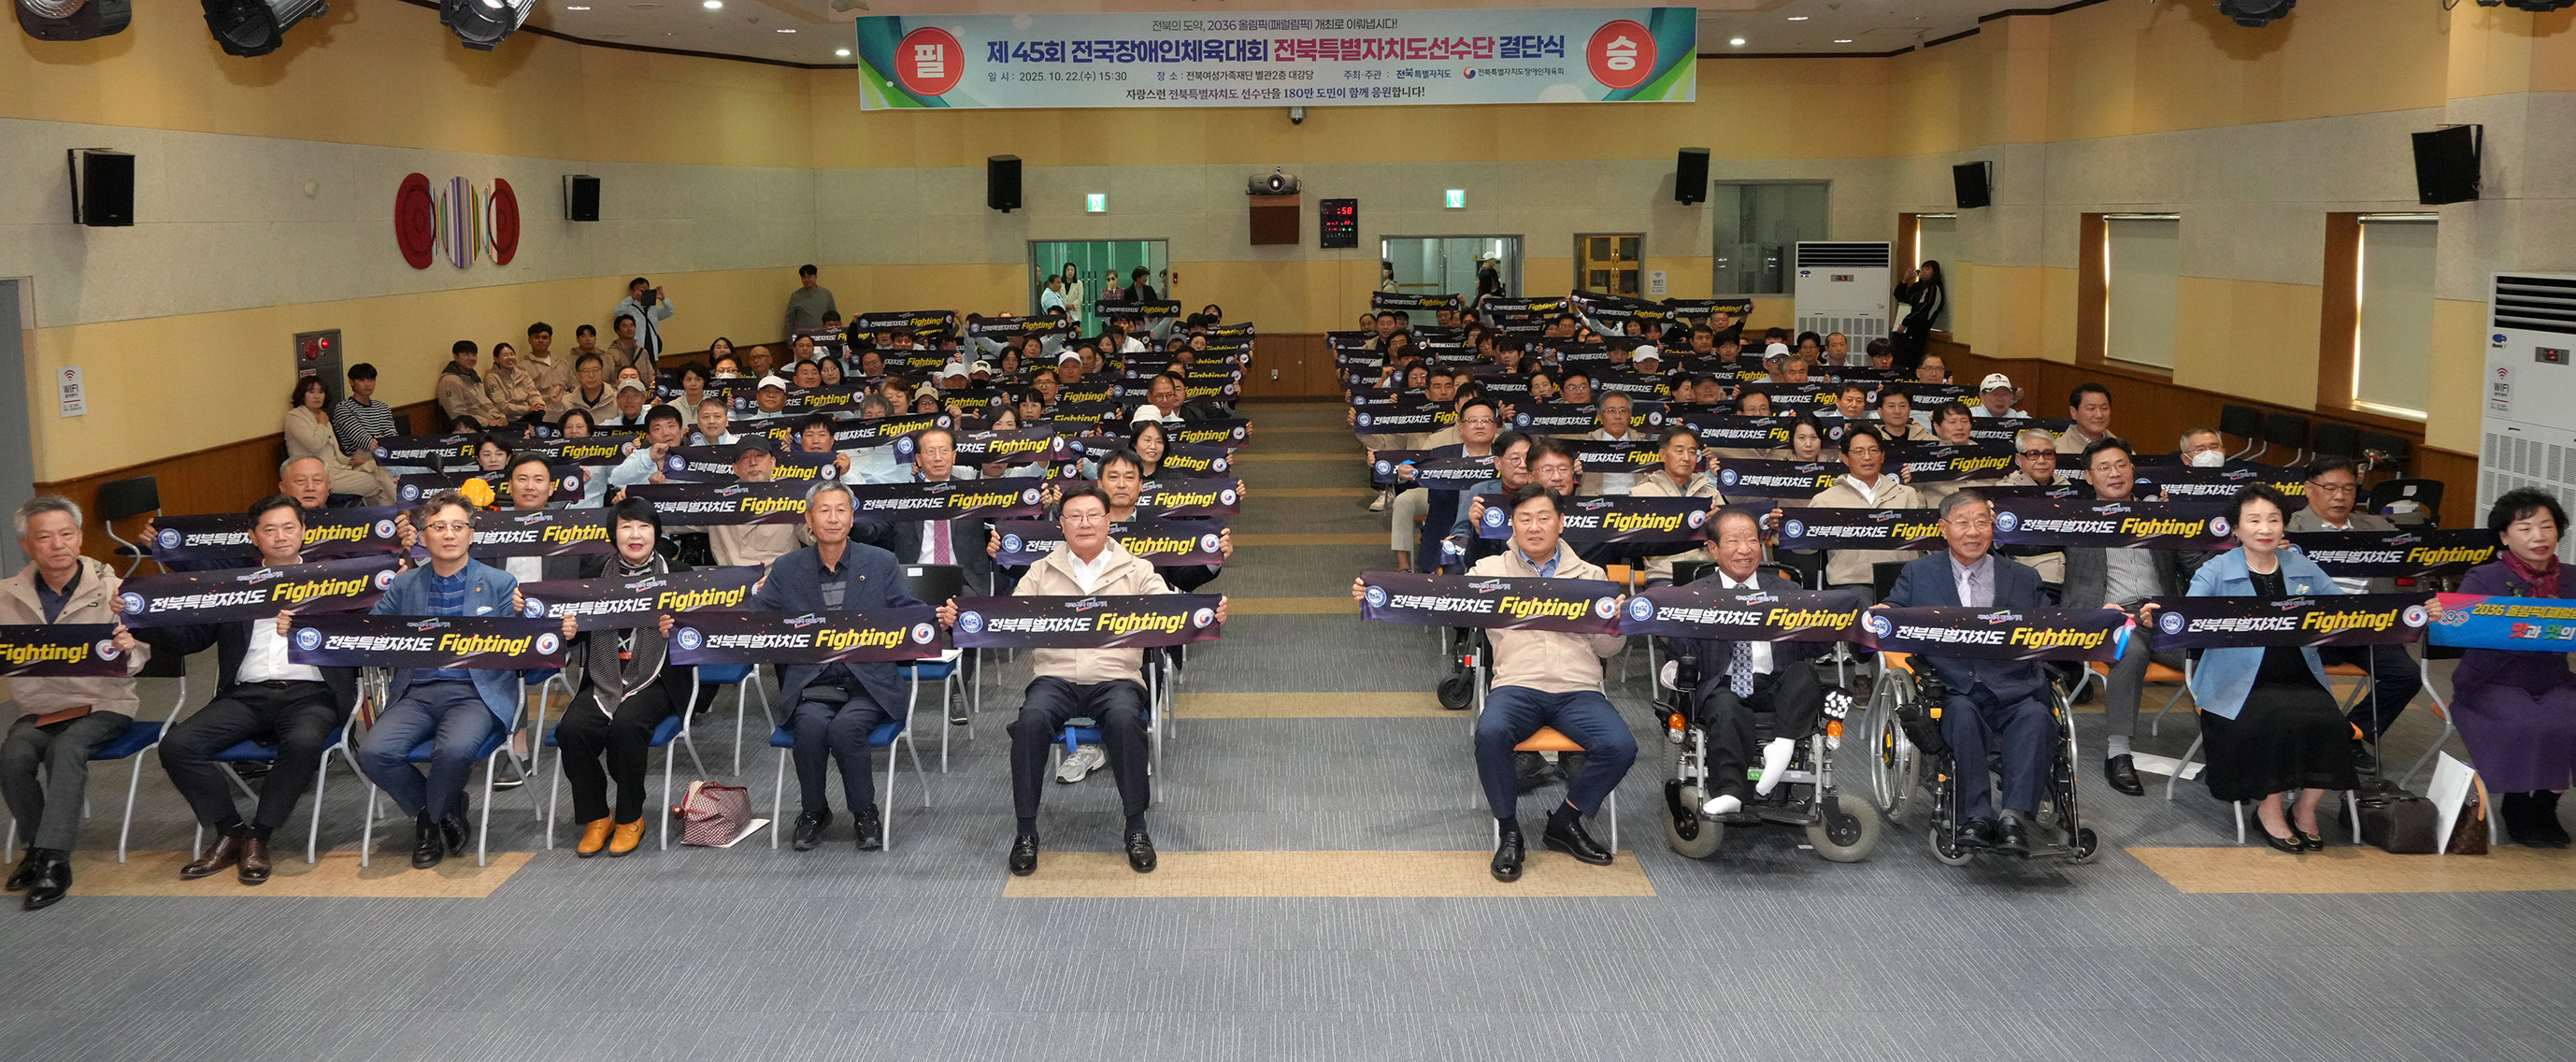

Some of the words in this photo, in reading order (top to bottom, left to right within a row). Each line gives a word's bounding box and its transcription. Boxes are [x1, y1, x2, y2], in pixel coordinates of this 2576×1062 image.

[1152, 20, 1181, 32] 전북의
[1183, 20, 1206, 33] 도약,
[1208, 20, 1237, 31] 2036
[1238, 19, 1312, 31] 올림픽(패럴림픽)
[1315, 19, 1344, 30] 개최로
[1346, 18, 1398, 30] 이뤄냅시다!
[987, 40, 1009, 63] 제
[1011, 40, 1066, 63] 45회
[1071, 39, 1268, 64] 전국장애인체육대회
[1274, 36, 1495, 62] 전북특별자치도선수단
[1499, 35, 1565, 59] 결단식
[1606, 35, 1638, 71] 승
[913, 43, 945, 79] 필
[1019, 71, 1046, 81] 2025.
[1049, 71, 1064, 81] 10.
[1066, 71, 1096, 82] 22.(수)
[1099, 71, 1127, 81] 15:30
[1186, 70, 1253, 81] 전북여성가족재단
[1255, 70, 1287, 80] 별관2층
[1288, 69, 1314, 80] 대강당
[1343, 69, 1381, 80] 주최·주관
[1477, 65, 1565, 77] 전북특별자치도장애인체육회
[1125, 88, 1166, 100] 자랑스런
[1168, 88, 1238, 100] 전북특별자치도
[1241, 87, 1281, 100] 선수단을
[1283, 87, 1314, 99] 180만
[1316, 86, 1346, 99] 도민이
[1349, 86, 1369, 98] 함께
[1371, 85, 1425, 98] 응원합니다!
[1418, 298, 1449, 307] Fighting!
[909, 317, 944, 326] Fighting!
[1634, 309, 1666, 320] Fighting!
[1021, 321, 1056, 330] Fighting!
[907, 357, 945, 367] Fighting!
[63, 383, 79, 393] WIFI
[1601, 382, 1653, 393] 전북특별자치도
[2494, 381, 2510, 393] WIFI
[804, 393, 851, 407] Fighting!
[1063, 391, 1108, 403] Fighting!
[1373, 413, 1432, 425] 전북특별자치도
[1532, 416, 1592, 426] 전북특별자치도
[879, 419, 934, 437] Fighting!
[1180, 429, 1230, 442] Fighting!
[1701, 428, 1767, 439] 전북특별자치도
[561, 444, 619, 459] Fighting!
[988, 438, 1051, 453] Fighting!
[1164, 456, 1210, 470] ghting!
[1949, 454, 2012, 471] Fighting!
[770, 465, 818, 481] ghting!
[1420, 468, 1494, 480] 전북특별자치도
[1739, 475, 1813, 488] 전북특별자치도
[653, 500, 737, 513] 전북특별자치도
[739, 497, 806, 514] Fighting
[863, 498, 944, 510] 전북특별자치도
[948, 491, 1019, 509] Fighting!
[1154, 492, 1217, 509] Fighting!
[1602, 512, 1683, 532] Fighting!
[2020, 518, 2115, 534] 전북특별자치도
[2119, 518, 2205, 538] Fighting!
[304, 523, 370, 545] ghting!
[1806, 524, 1887, 538] 전북특별자치도
[2307, 550, 2405, 564] 전북특별자치도
[2406, 545, 2495, 566] Fighting!
[150, 588, 267, 613] 전북특별자치도
[271, 575, 369, 603] Fighting!
[549, 596, 653, 618] 전북특별자치도
[657, 585, 746, 612] Fighting!
[1390, 594, 1495, 613] 전북특별자치도
[1497, 596, 1590, 620] Fighting!
[2471, 603, 2506, 616] 2036
[987, 617, 1092, 633] 전북특별자치도
[1095, 610, 1189, 634] Fighting!
[1656, 606, 1763, 625] 전북특별자치도
[1766, 608, 1858, 631] Fighting!
[2187, 616, 2298, 632] 전북특별자치도
[2301, 609, 2397, 633] Fighting!
[1896, 625, 2005, 645] 전북특별자치도
[2010, 627, 2108, 650] Fighting!
[2509, 622, 2542, 639] 맛과
[324, 637, 435, 653] 전북특별자치도
[437, 633, 531, 657] Fighting!
[706, 633, 811, 650] 전북특별자치도
[815, 626, 907, 651] Fighting!
